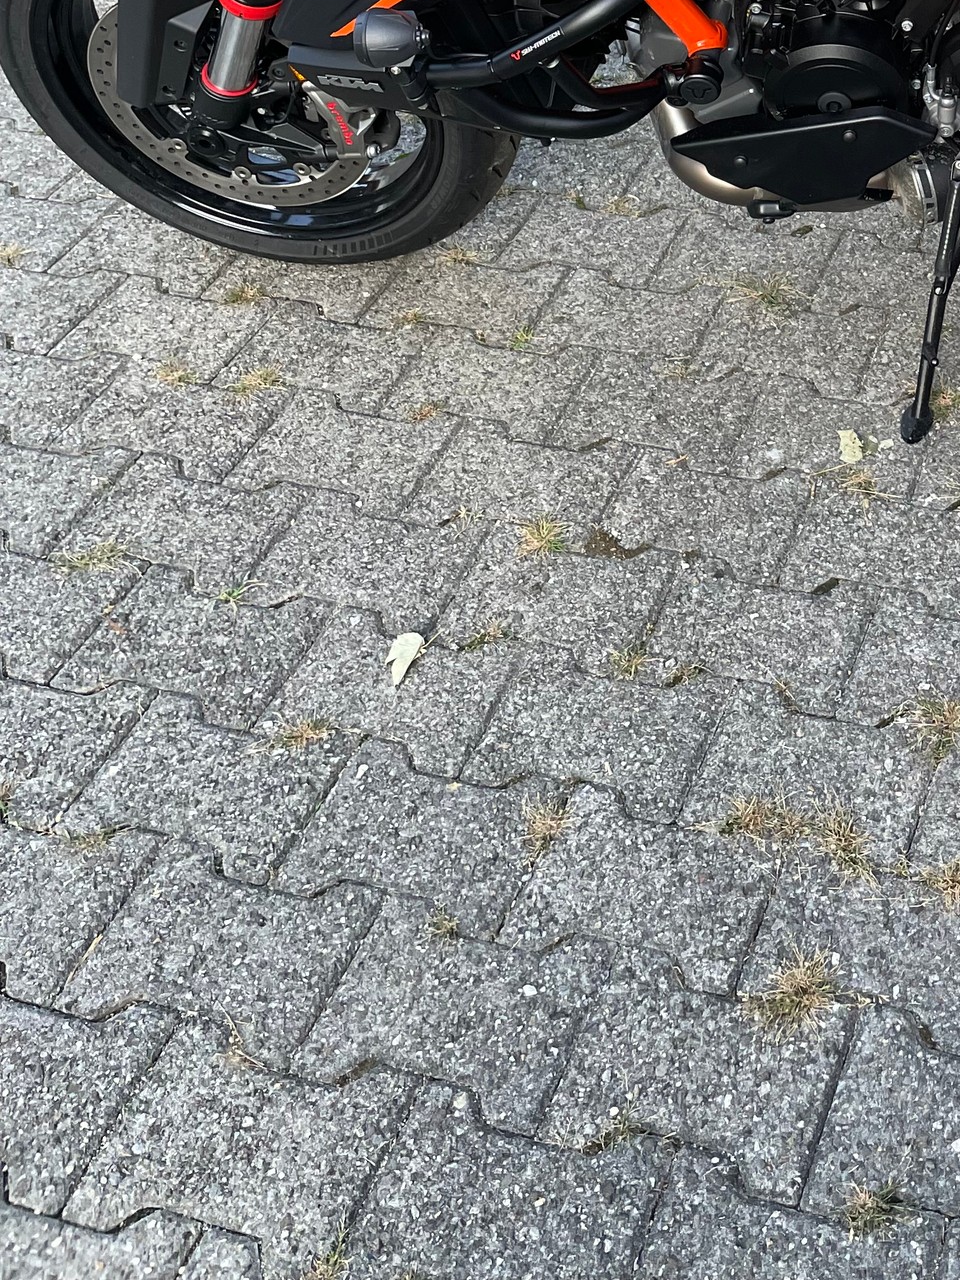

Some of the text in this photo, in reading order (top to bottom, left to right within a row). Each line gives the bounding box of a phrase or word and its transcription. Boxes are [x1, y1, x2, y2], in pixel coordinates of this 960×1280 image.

[520, 29, 561, 57] SW-MOTECH
[316, 74, 384, 94] KTM
[326, 101, 354, 146] brembo
